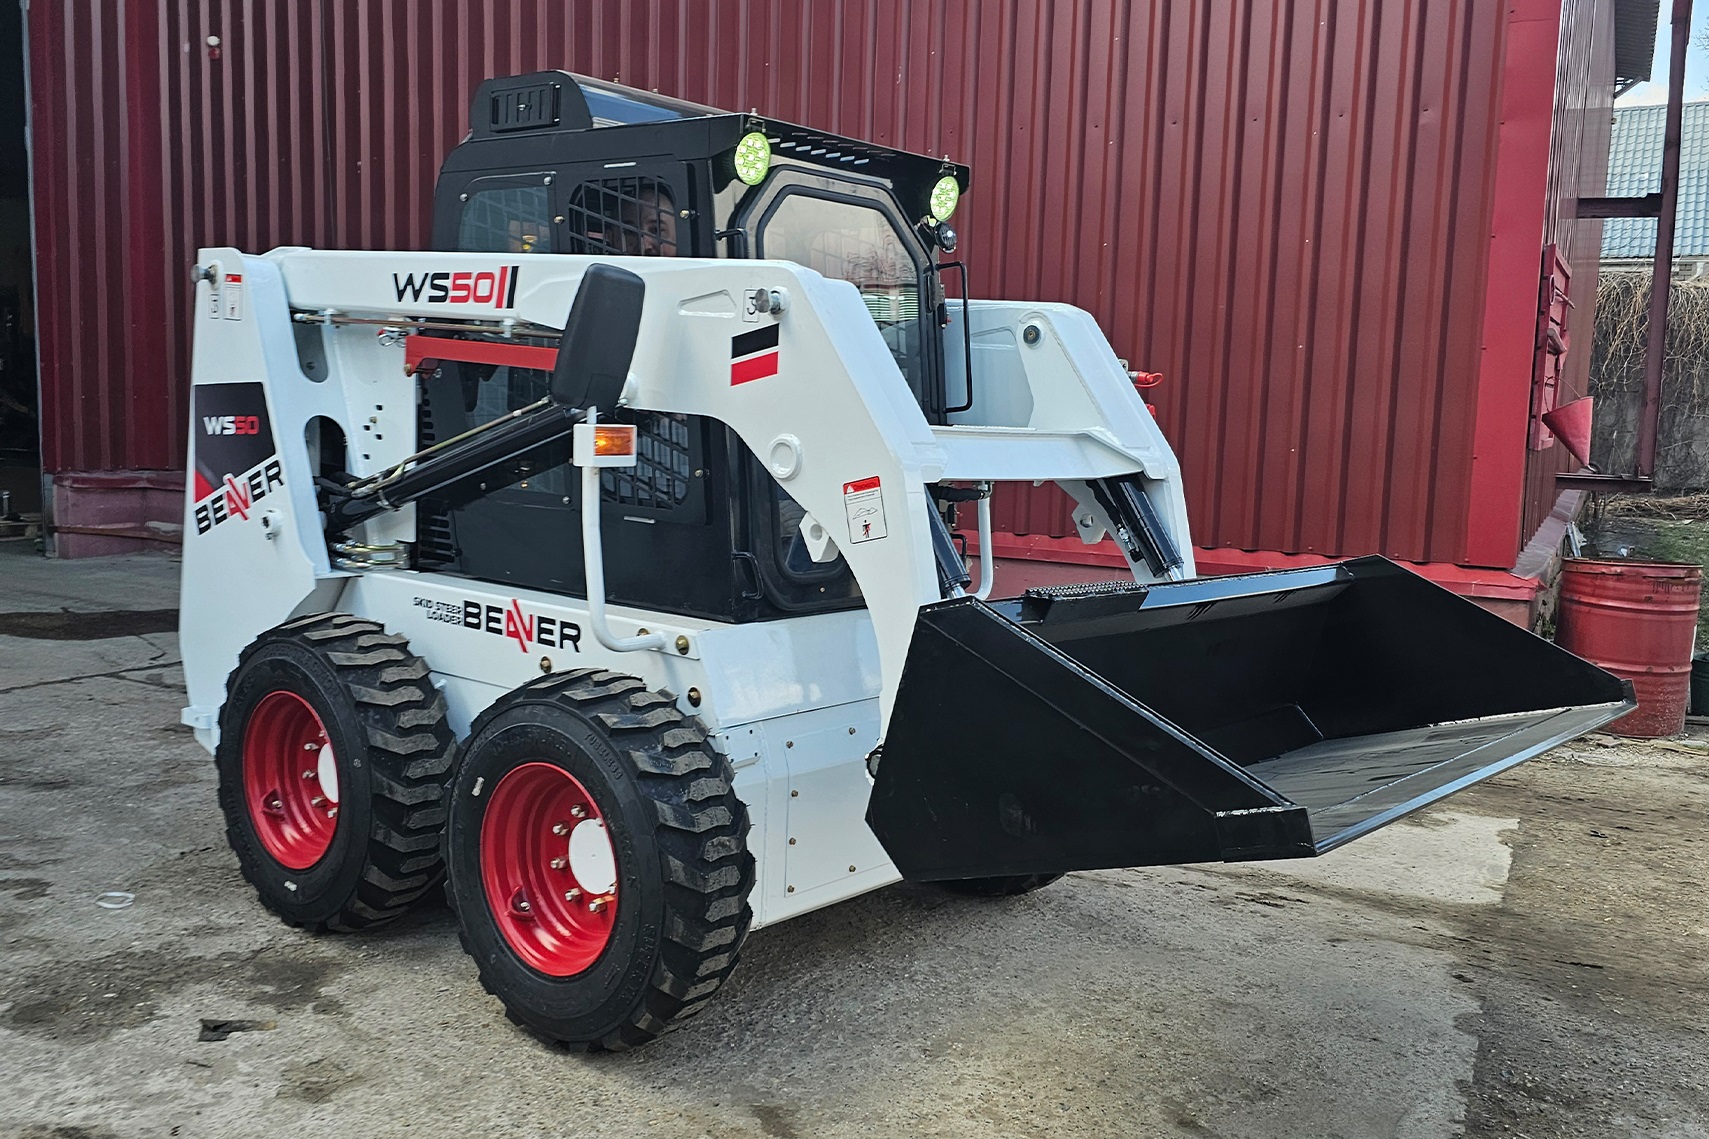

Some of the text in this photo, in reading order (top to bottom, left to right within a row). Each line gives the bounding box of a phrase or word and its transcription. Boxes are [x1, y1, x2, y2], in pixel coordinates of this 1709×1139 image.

[203, 415, 259, 435] WS50
[194, 459, 284, 536] BEAVER
[412, 596, 463, 616] SKID STEER
[426, 609, 463, 627] LOADER
[463, 599, 581, 653] BEAVER
